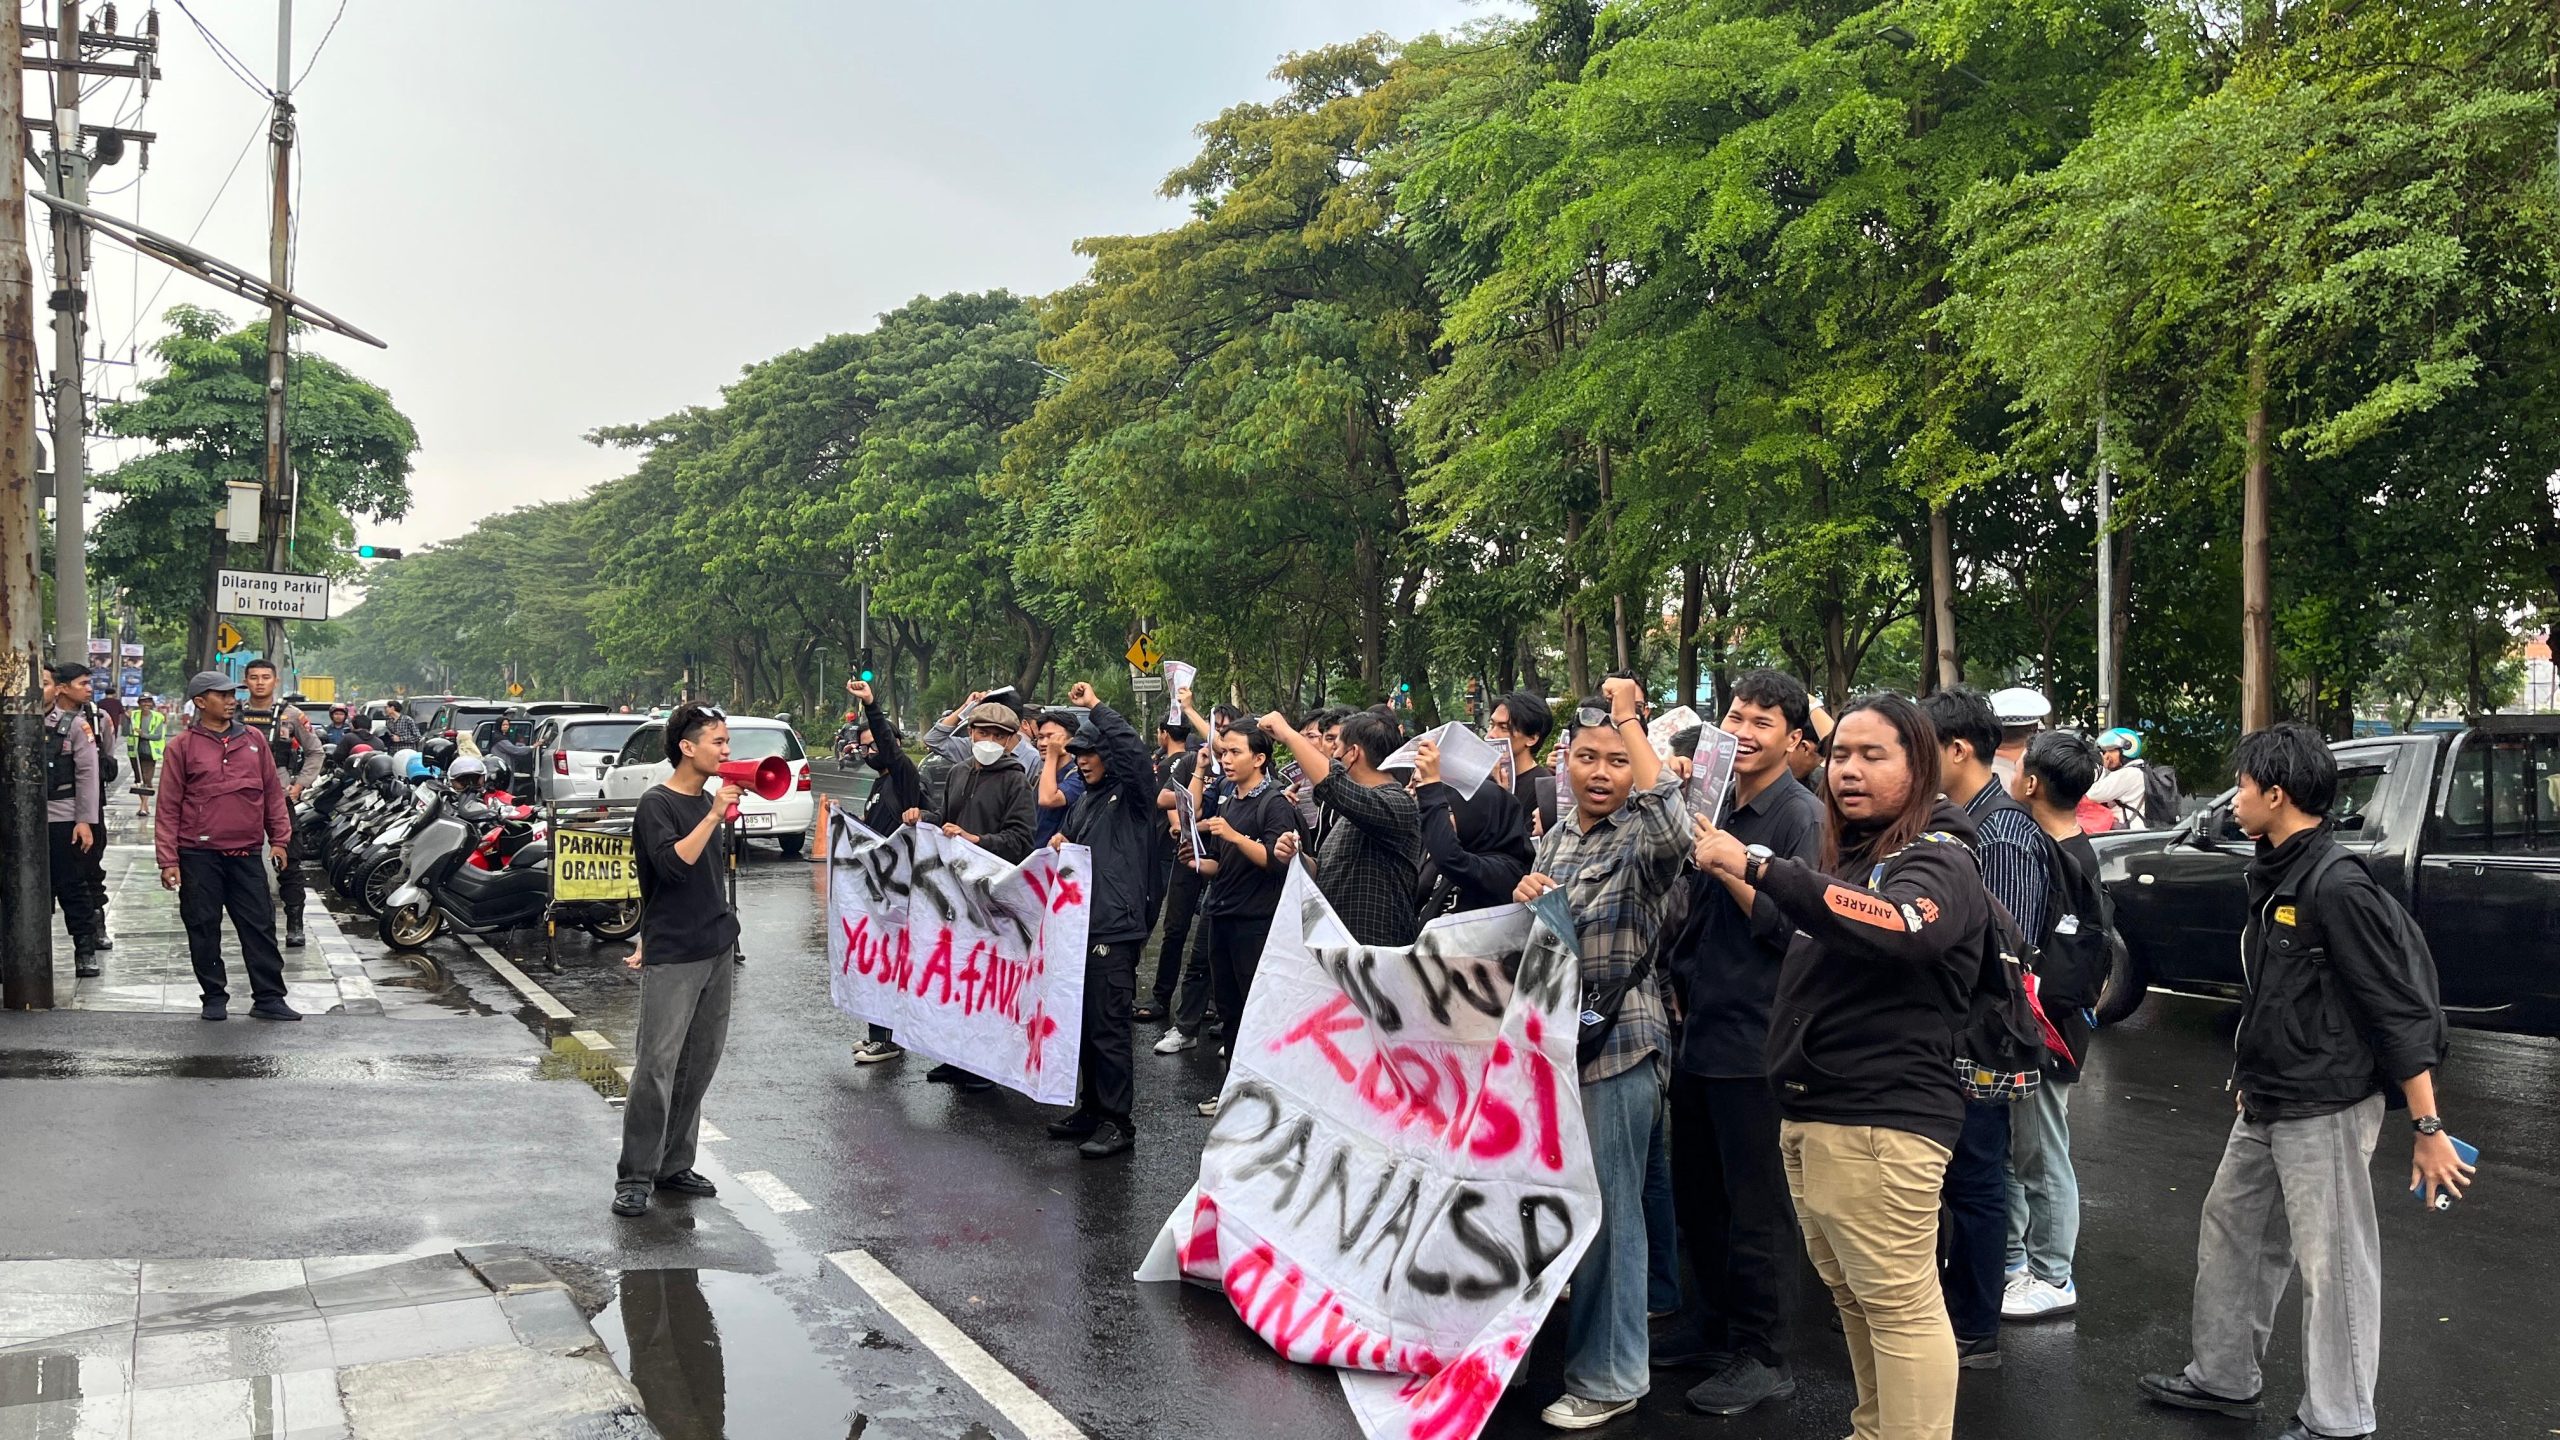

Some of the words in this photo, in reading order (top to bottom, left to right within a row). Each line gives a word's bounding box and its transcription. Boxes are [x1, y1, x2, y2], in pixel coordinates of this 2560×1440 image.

[222, 575, 277, 593] Dilarang
[284, 581, 322, 594] Parkir
[239, 597, 251, 608] Di
[259, 598, 304, 612] Trotoar
[560, 834, 624, 855] PARKIR
[562, 860, 621, 880] ORANG
[1835, 894, 1892, 919] ANTARES
